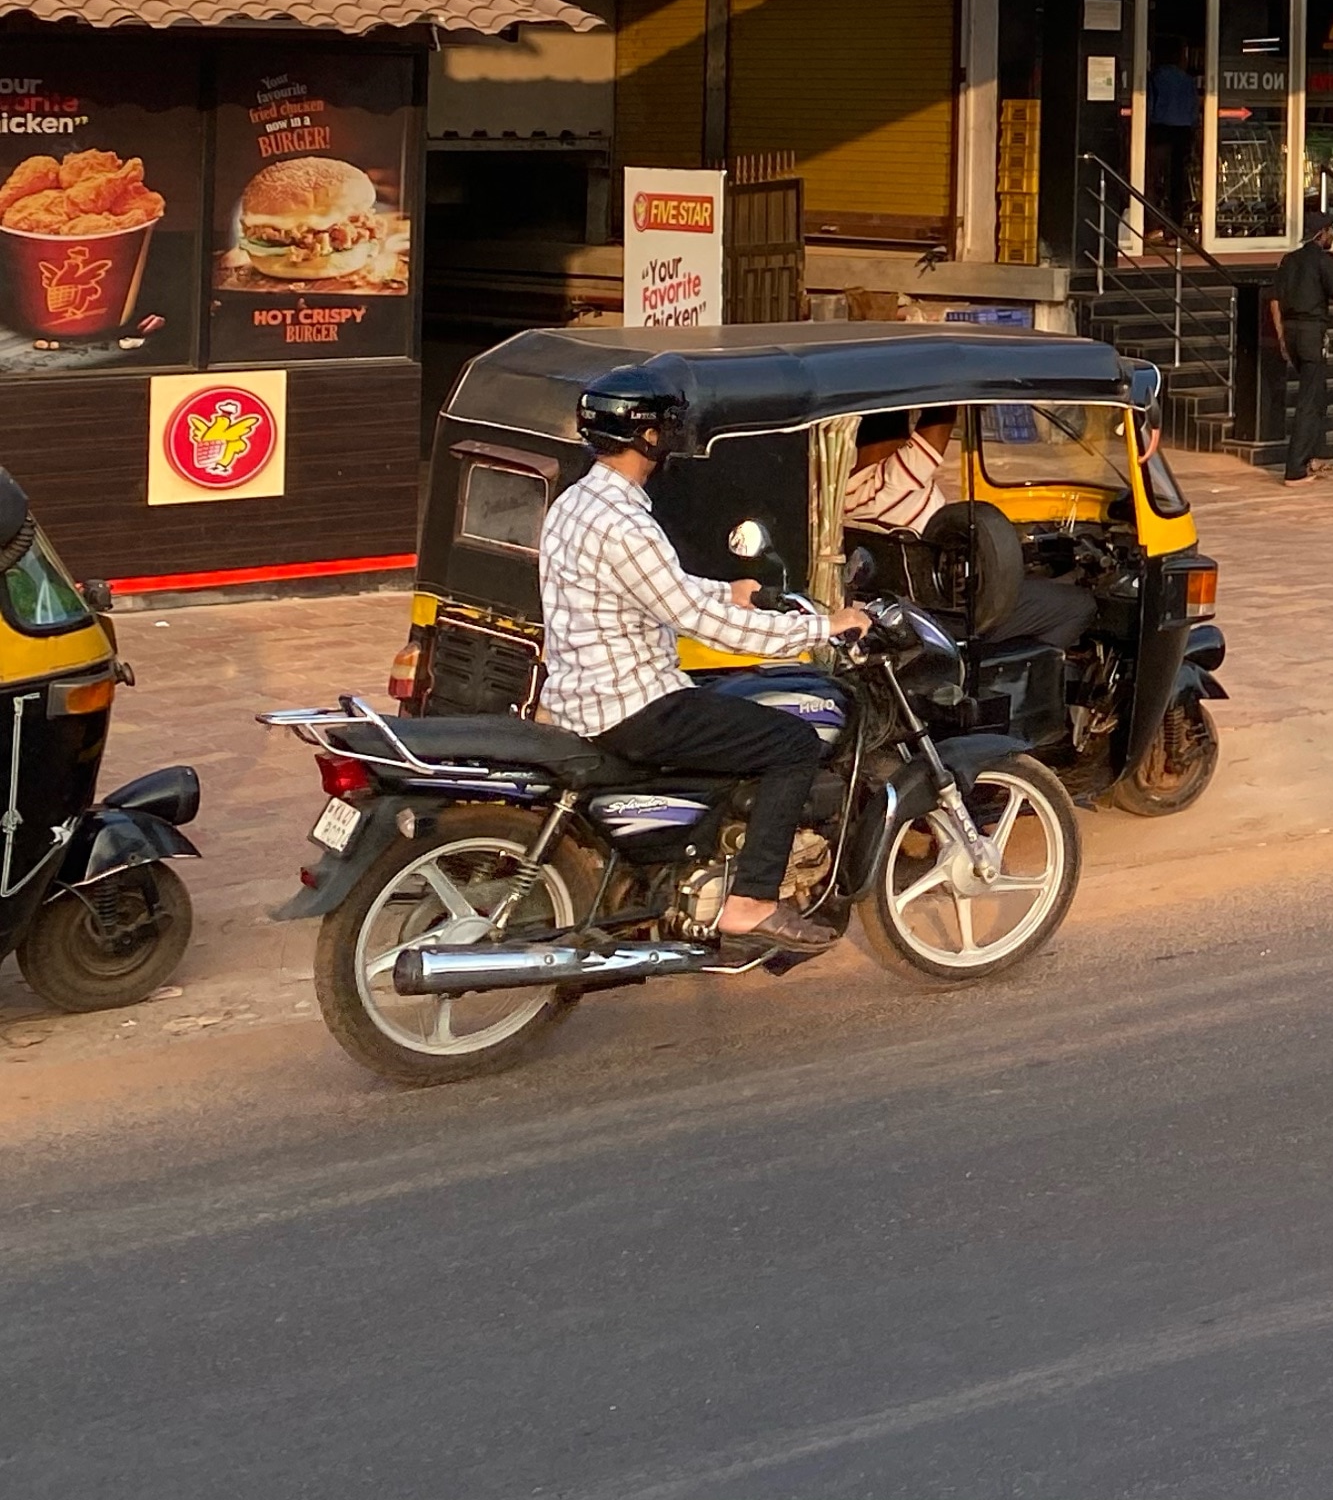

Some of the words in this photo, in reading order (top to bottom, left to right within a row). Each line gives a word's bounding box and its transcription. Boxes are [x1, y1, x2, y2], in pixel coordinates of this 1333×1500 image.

[249, 102, 278, 124] fried
[258, 126, 330, 158] BURGER!
[642, 272, 702, 313] Favorite
[254, 309, 295, 326] HOT
[298, 306, 366, 324] CRISPY
[286, 324, 338, 343] BURGER
